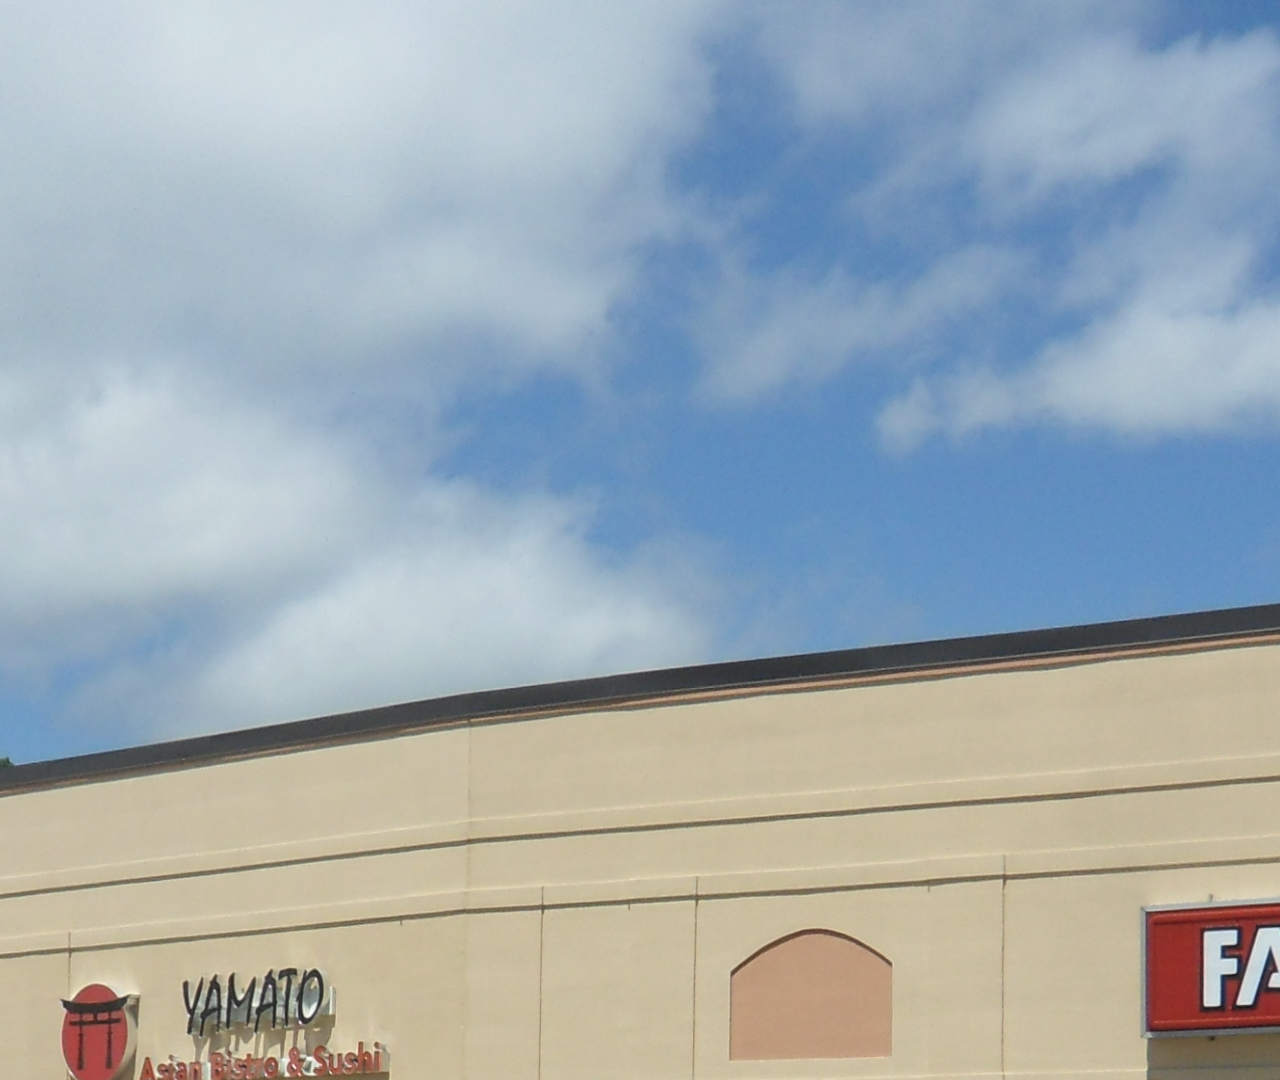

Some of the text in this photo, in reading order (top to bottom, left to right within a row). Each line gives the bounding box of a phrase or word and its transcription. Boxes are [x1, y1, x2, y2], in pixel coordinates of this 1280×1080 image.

[183, 968, 325, 1037] YAMATO
[209, 1052, 279, 1080] Bistro
[286, 1046, 305, 1077] &
[313, 1042, 383, 1076] Sushi
